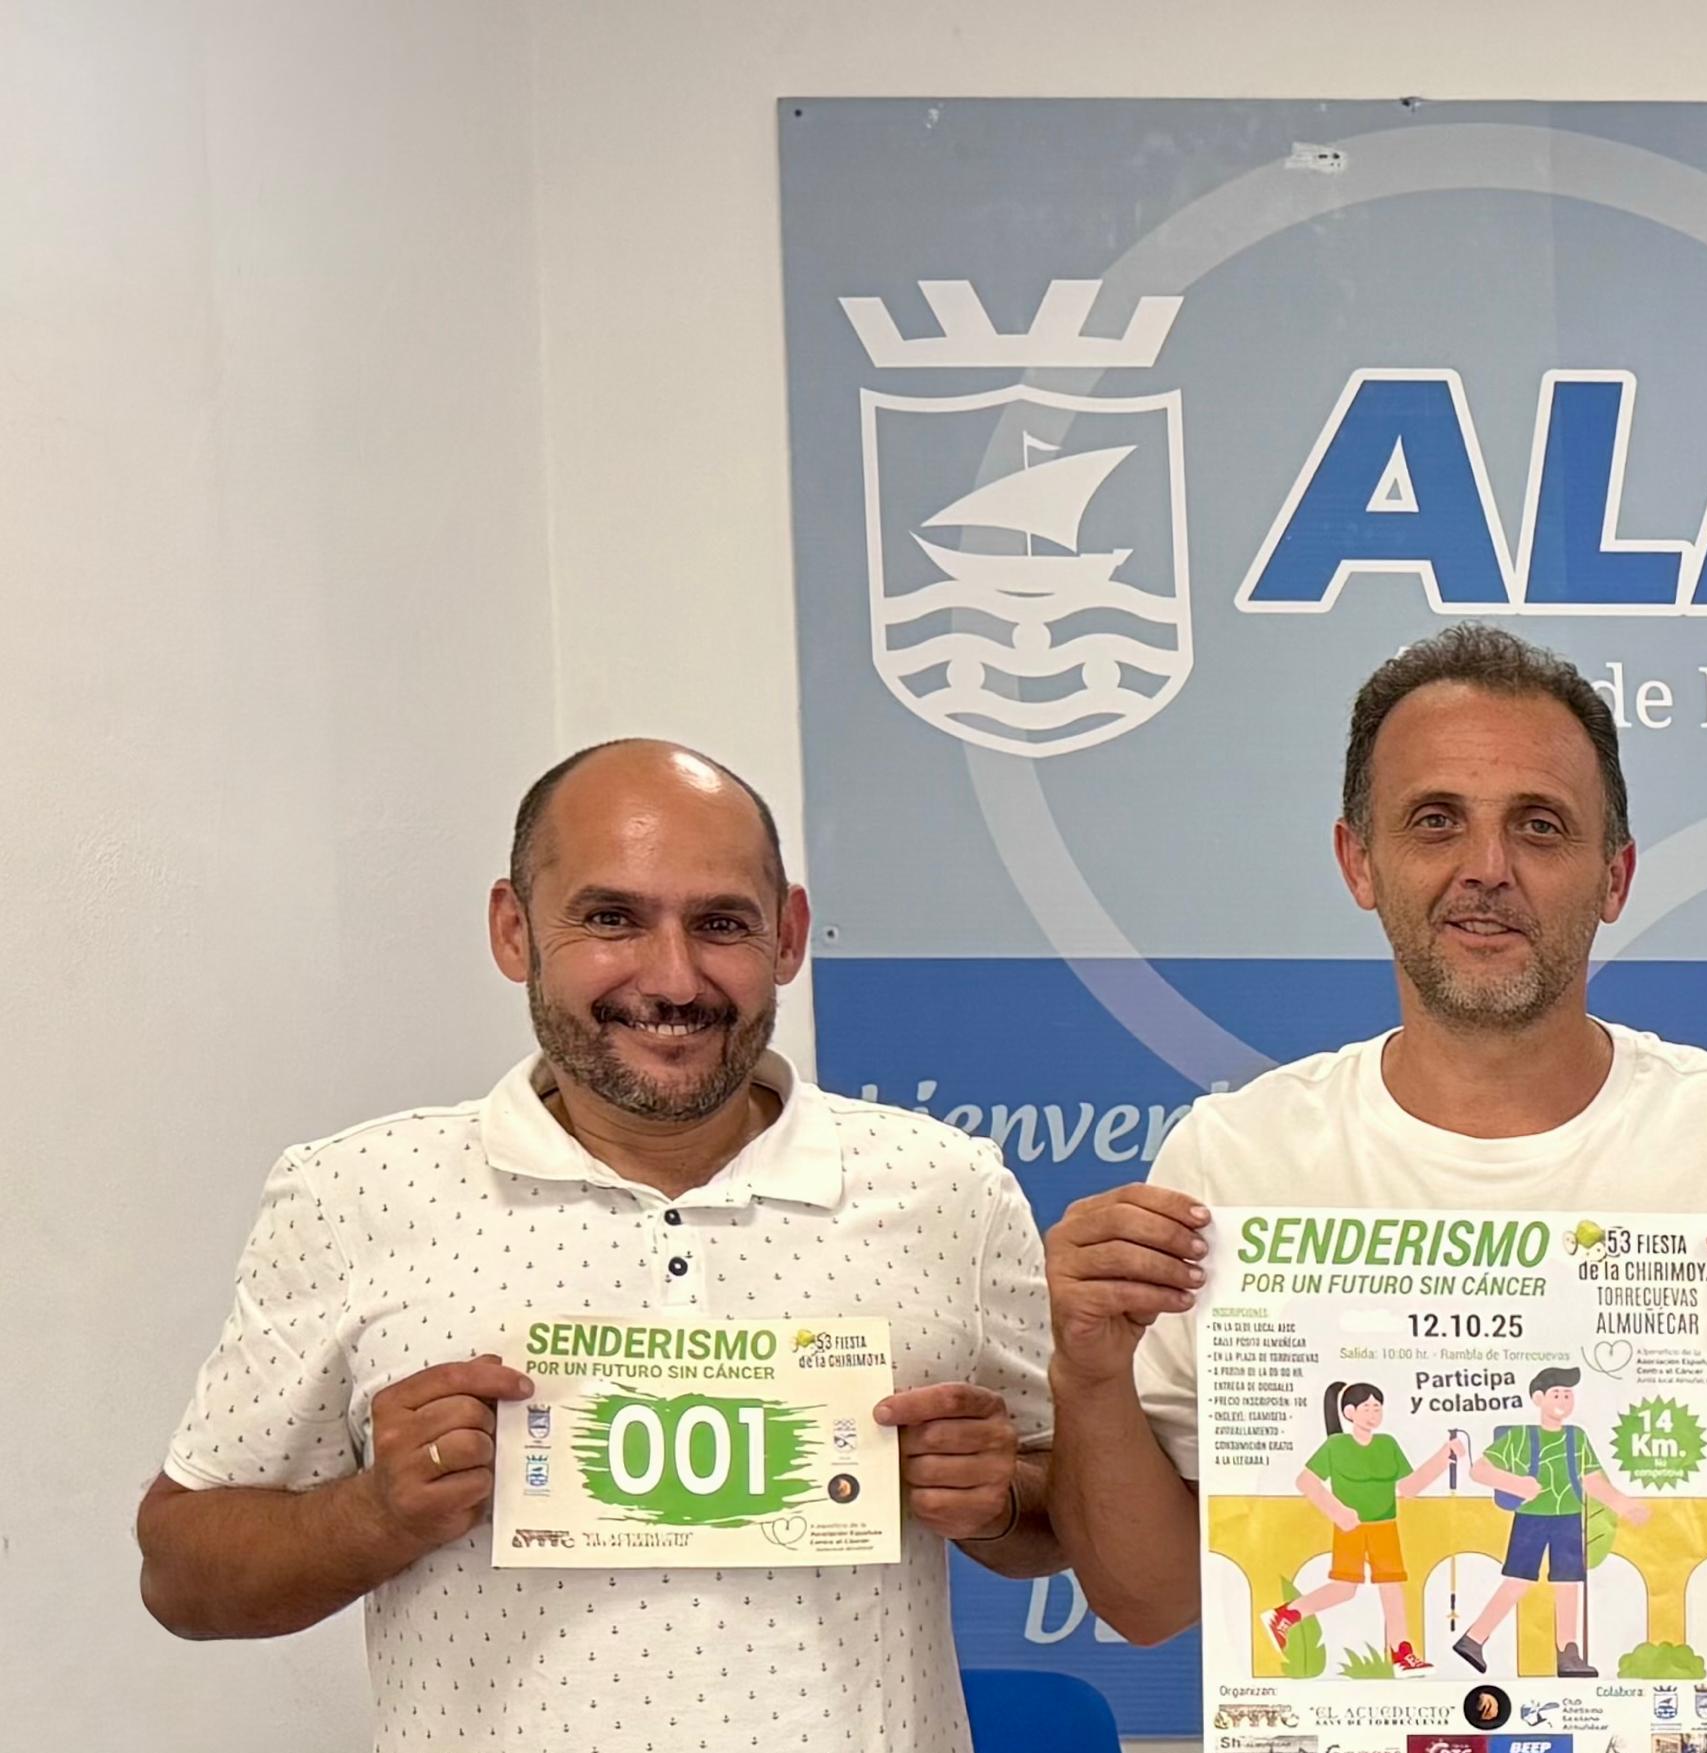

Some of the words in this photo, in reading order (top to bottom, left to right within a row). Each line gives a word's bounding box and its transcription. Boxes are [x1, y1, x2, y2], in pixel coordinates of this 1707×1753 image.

[1596, 662, 1674, 730] de
[1238, 1217, 1550, 1268] SENDERISMO
[1607, 1230, 1631, 1254] 53
[1638, 1235, 1687, 1254] FIESTA
[1579, 1262, 1598, 1280] de
[1605, 1262, 1620, 1280] la
[1241, 1274, 1284, 1293] POR
[1292, 1275, 1322, 1293] UN
[1329, 1275, 1412, 1294] FUTURO
[1420, 1276, 1455, 1295] SIN
[1462, 1273, 1546, 1296] CÁNCER
[1598, 1287, 1698, 1307] TORRECUEVAS
[1408, 1314, 1523, 1338] 12.10.25
[1596, 1307, 1699, 1334] ALMUÑÉCAR
[526, 1323, 776, 1361] SENDERISMO
[815, 1333, 832, 1350] 53
[835, 1336, 867, 1350] FIESTA
[829, 1354, 887, 1367] CHIRIMOYA
[1340, 1348, 1378, 1360] Salida:
[1383, 1349, 1413, 1360] 10:00
[1440, 1349, 1482, 1360] Rambla
[1485, 1350, 1499, 1360] de
[1503, 1349, 1570, 1362] Torrecuevas
[526, 1360, 560, 1375] POR
[565, 1362, 586, 1376] UN
[592, 1363, 662, 1379] FUTURO
[669, 1364, 697, 1379] SIN
[703, 1363, 775, 1380] CÁNCER
[1416, 1369, 1515, 1389] Participa
[1411, 1396, 1422, 1414] y
[1429, 1395, 1523, 1412] colabora
[1638, 1410, 1673, 1432] 14
[608, 1403, 766, 1495] 001
[1631, 1435, 1686, 1457] Km.
[1220, 1685, 1277, 1696] Organizan:
[1510, 1742, 1551, 1753] BEEP
